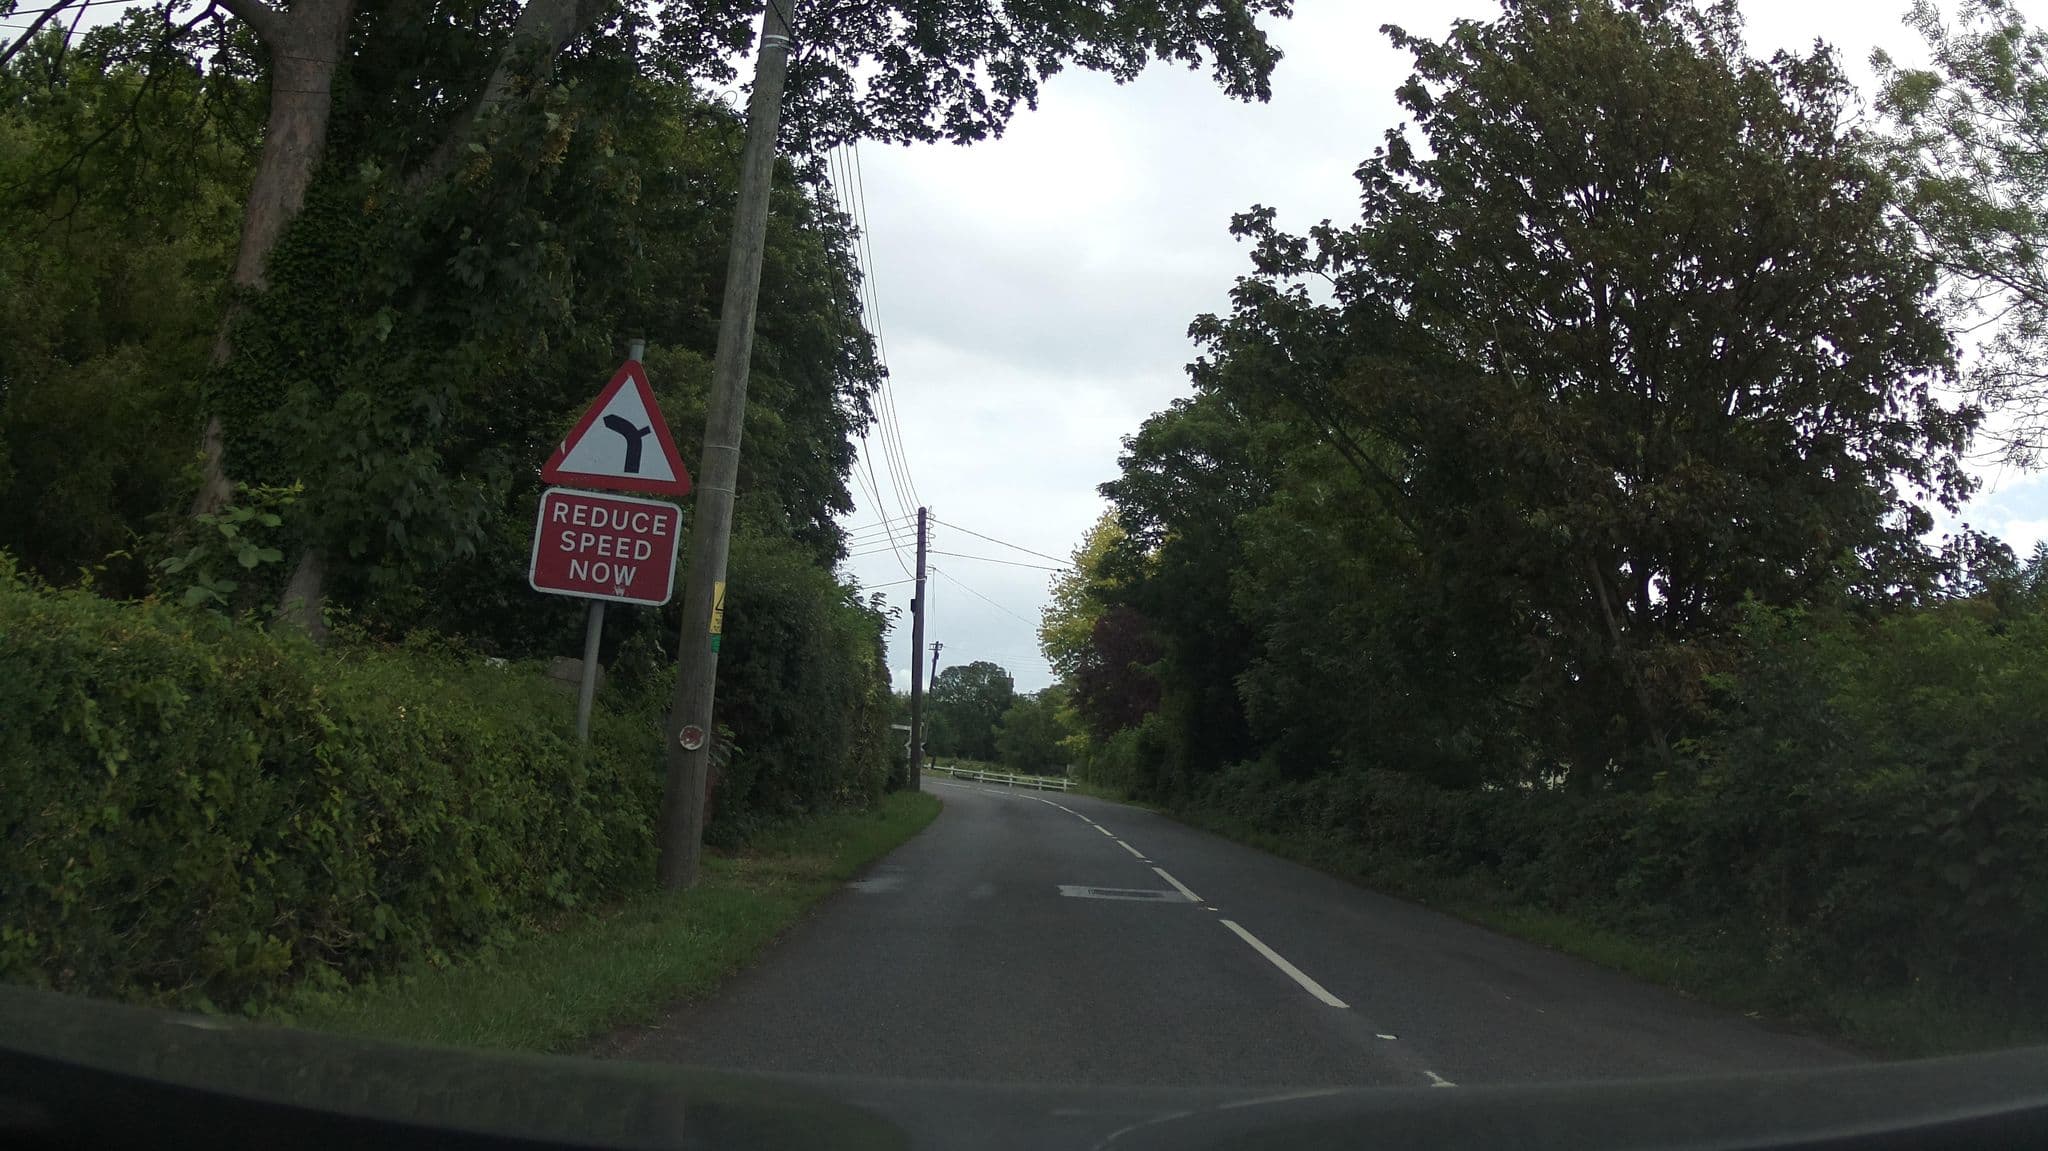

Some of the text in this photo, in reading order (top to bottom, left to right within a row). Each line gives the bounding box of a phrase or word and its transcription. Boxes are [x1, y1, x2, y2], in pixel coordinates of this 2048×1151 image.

[552, 502, 668, 536] REDUCE
[560, 530, 652, 561] SPEED
[569, 559, 637, 586] NOW
